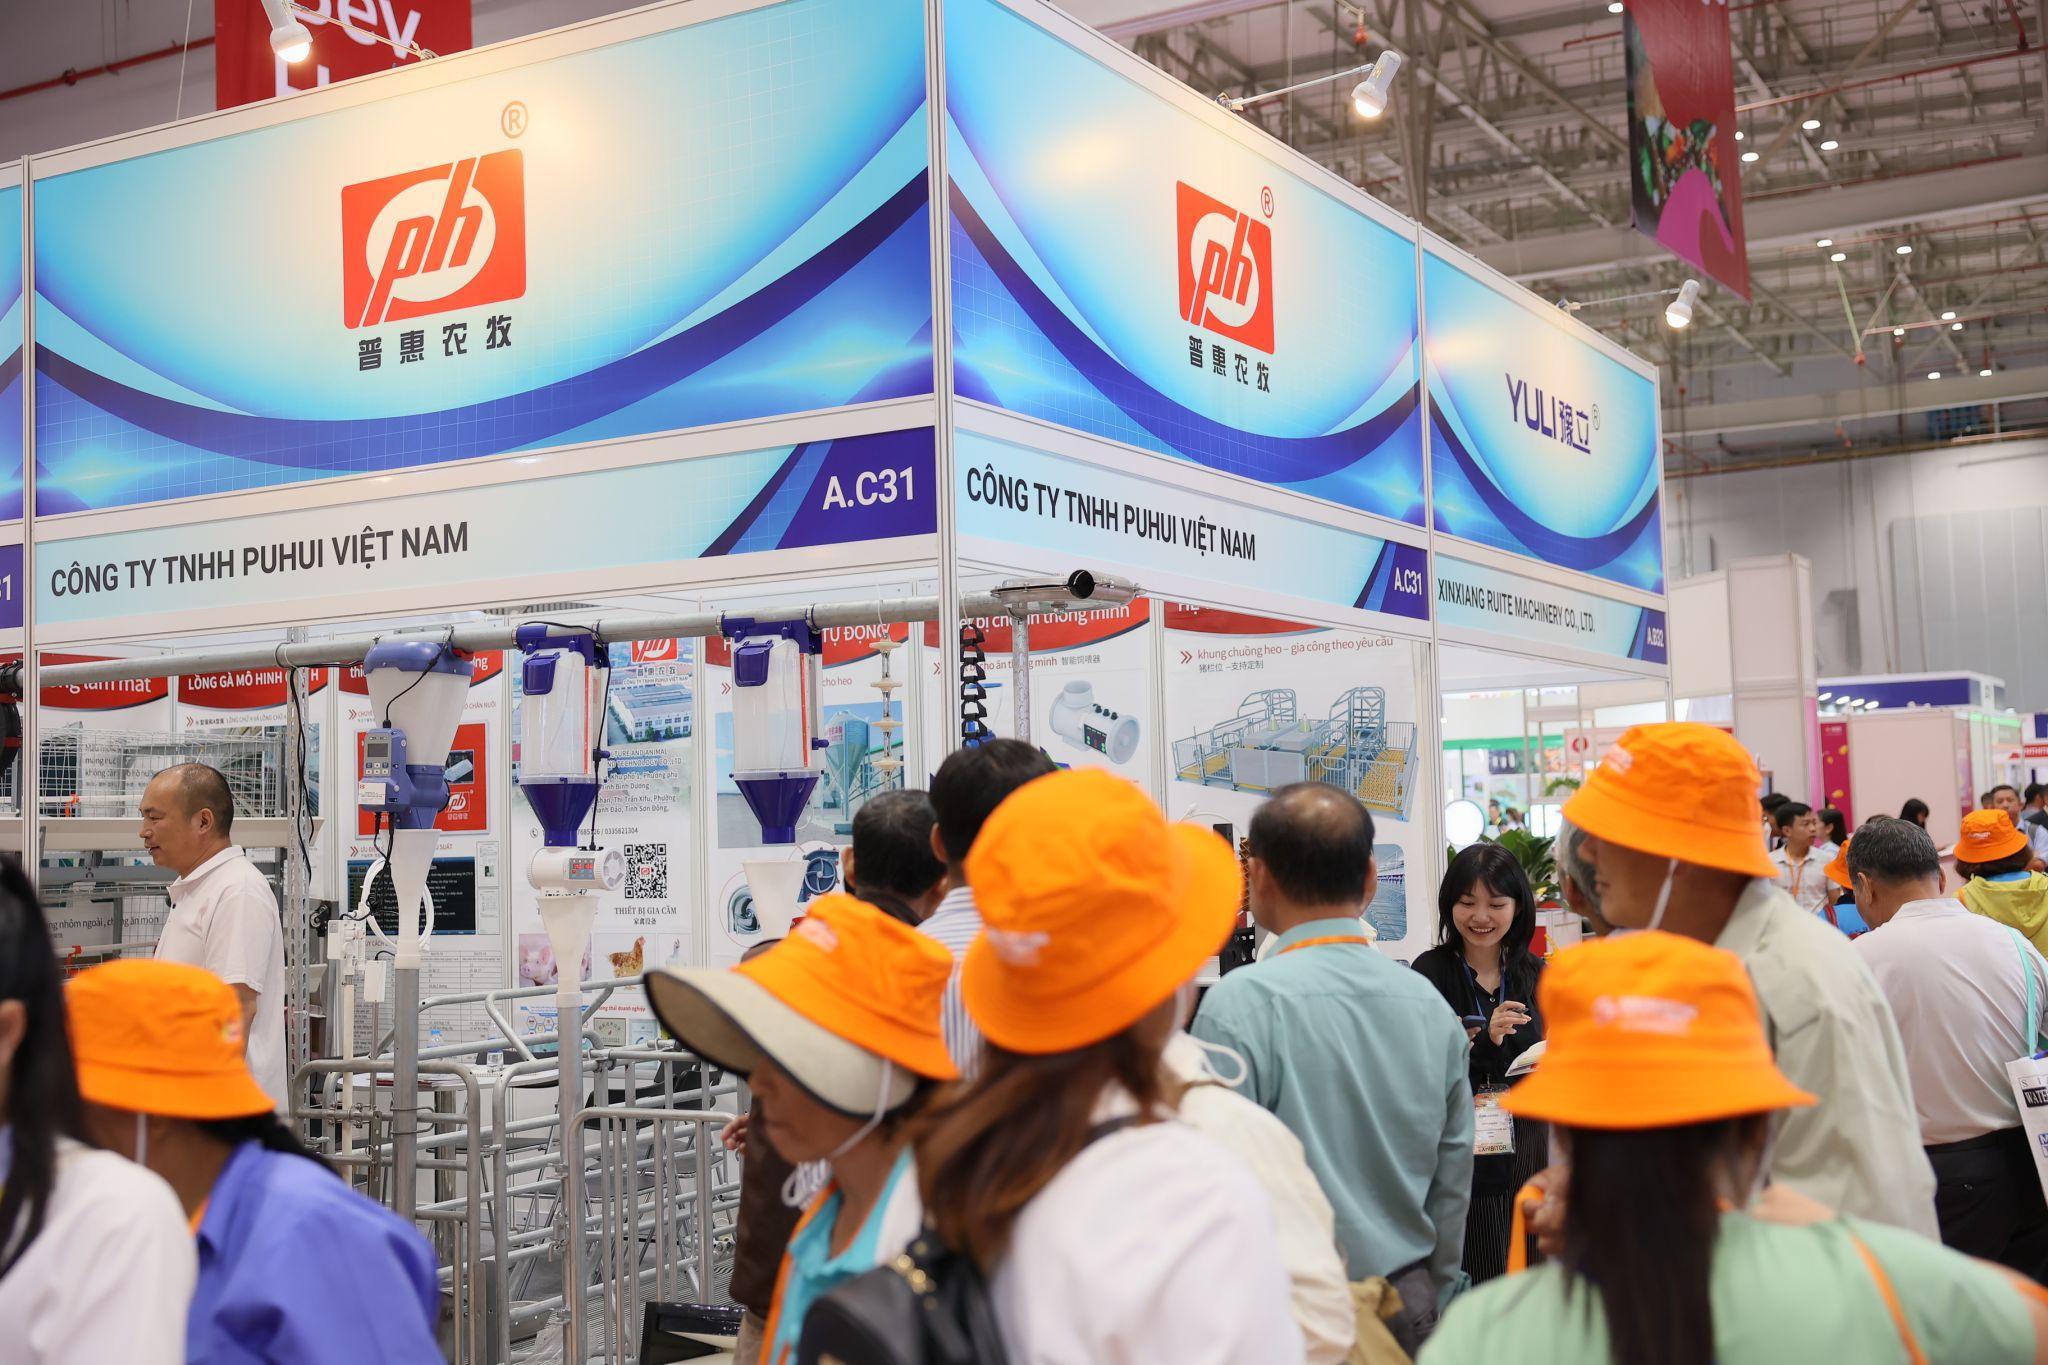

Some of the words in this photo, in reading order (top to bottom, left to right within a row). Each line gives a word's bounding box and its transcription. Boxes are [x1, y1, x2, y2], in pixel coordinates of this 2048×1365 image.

[358, 314, 512, 372] 普惠农牧
[1188, 335, 1270, 393] 普惠农牧
[1505, 372, 1557, 440] YULI
[822, 465, 914, 511] A.C31
[966, 463, 1029, 512] CÔNG
[1033, 482, 1060, 518] TY
[1064, 489, 1118, 532] TNHH
[1124, 503, 1176, 545] PUHUI
[1180, 515, 1217, 557] VIỆT
[1220, 526, 1256, 561] NAM
[51, 560, 119, 597] CÔNG
[124, 558, 157, 588] TY
[162, 549, 234, 585] TNHH
[243, 538, 323, 576] PUHUI
[331, 525, 394, 570] VIỆT
[401, 521, 468, 559] NAM
[0, 573, 11, 601] 1
[1393, 567, 1423, 596] A.C31
[1437, 577, 1485, 610] XINXIANG
[1487, 590, 1513, 616] RUITE
[1514, 596, 1563, 626] MACHINERY
[1580, 611, 1596, 632] LTD.
[1035, 657, 1058, 668] minh
[1198, 648, 1227, 661] khung
[1228, 644, 1263, 659] chuồng
[1264, 643, 1282, 656] heo
[1291, 642, 1305, 656] gia
[1306, 640, 1331, 654] công
[1332, 638, 1355, 651] theo
[1356, 636, 1374, 651] yêu
[188, 673, 217, 691] LỒNG
[219, 671, 234, 688] GÀ
[236, 670, 252, 688] MÔ
[837, 675, 853, 687] heo
[59, 918, 82, 929] nhôm
[615, 904, 637, 915] THIẾT
[637, 905, 646, 915] BỊ
[646, 905, 660, 914] GIA
